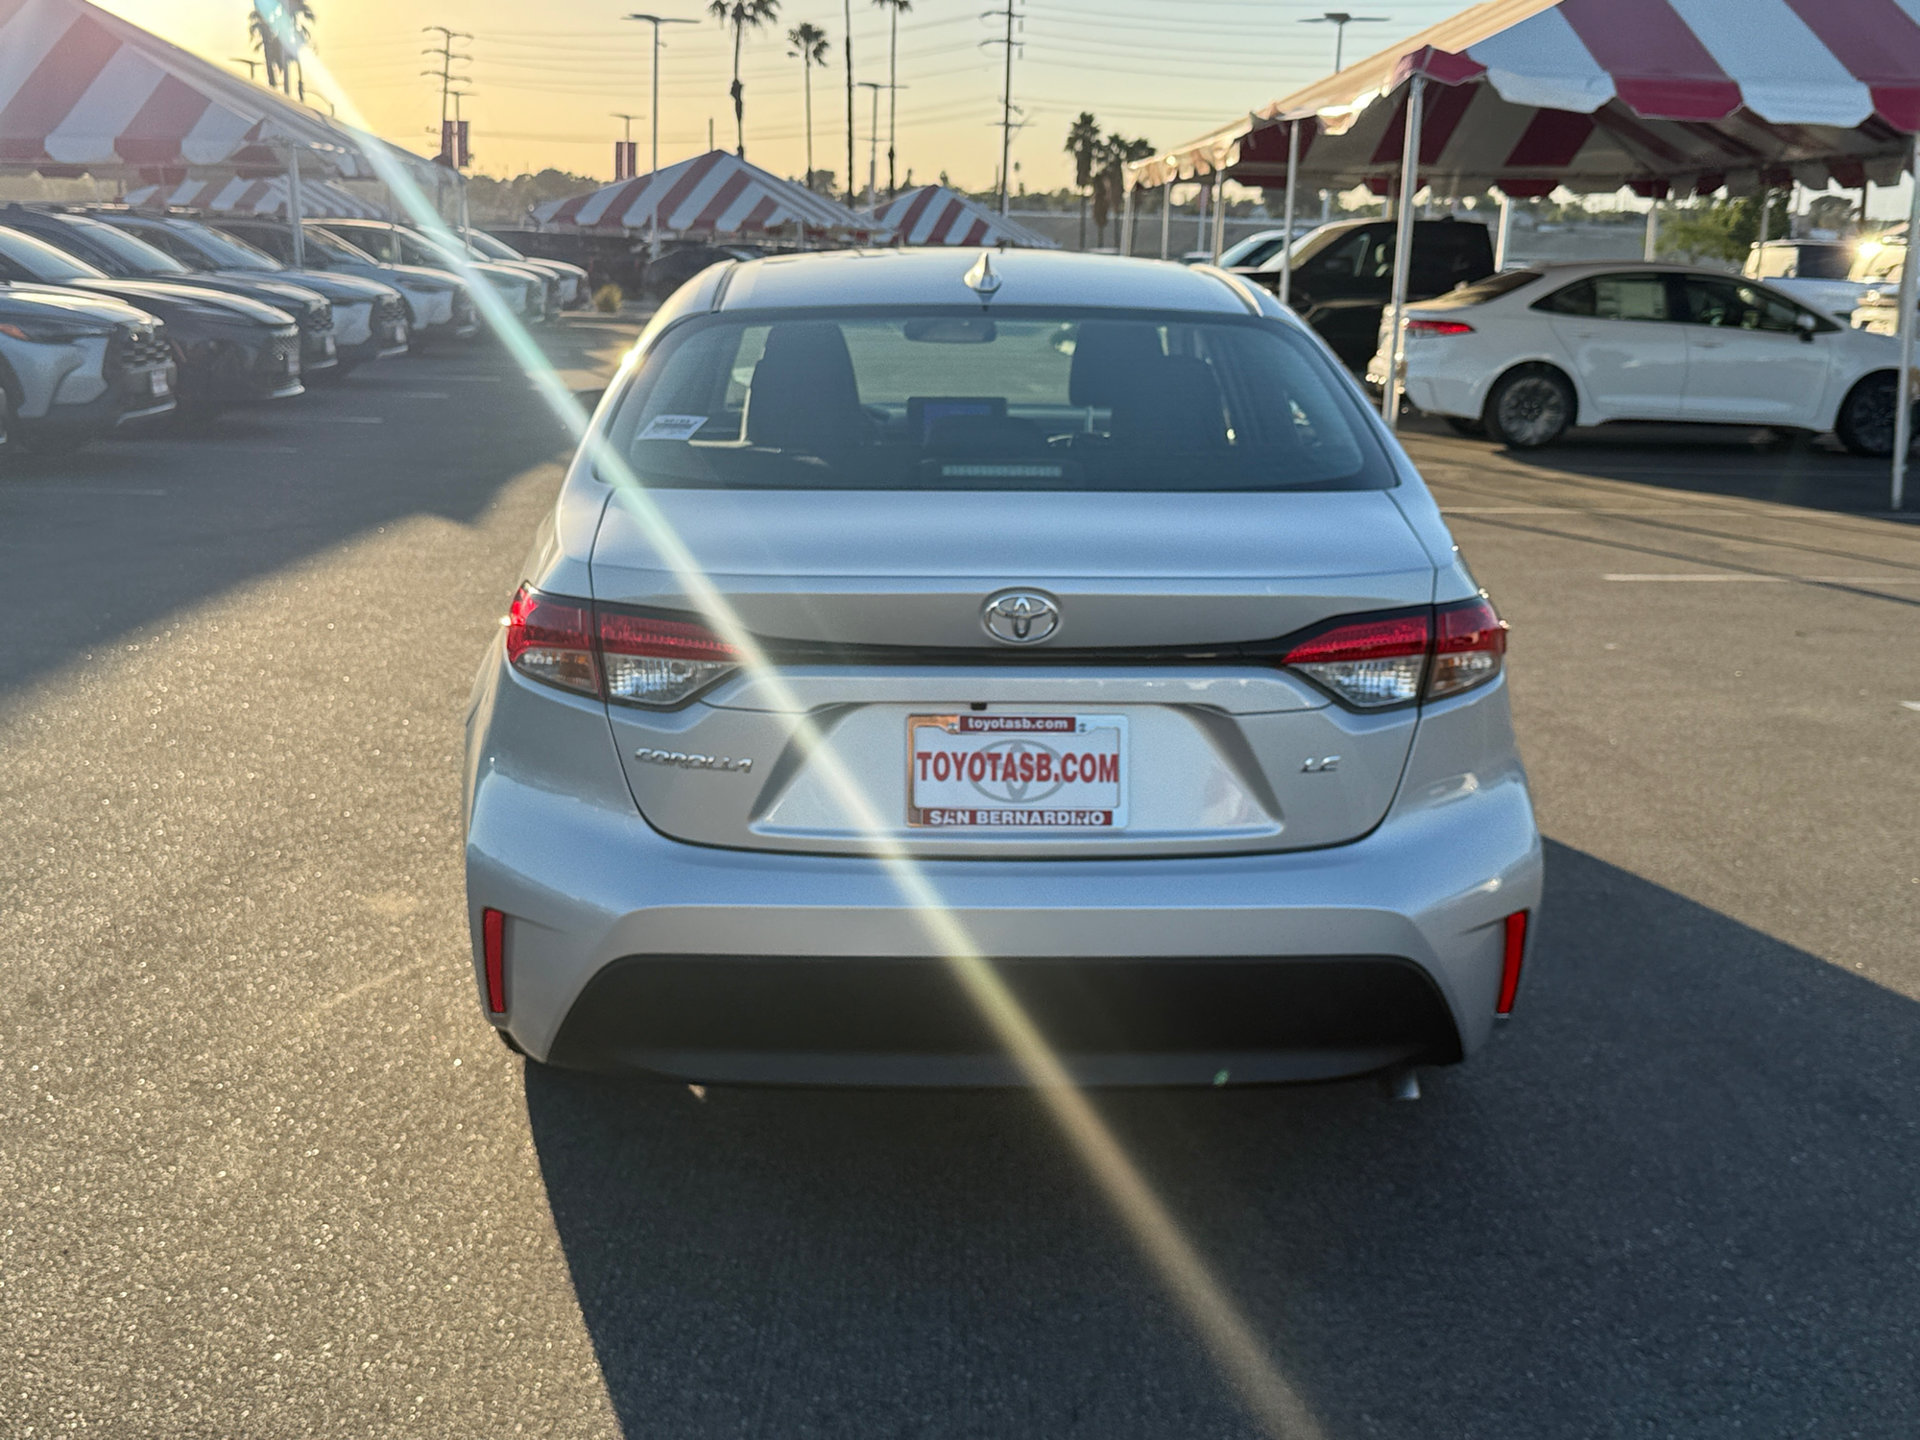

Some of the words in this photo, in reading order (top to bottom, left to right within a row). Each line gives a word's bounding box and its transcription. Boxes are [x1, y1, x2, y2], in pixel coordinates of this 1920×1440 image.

[967, 716, 1069, 732] toyotasb.com
[634, 747, 754, 773] COROLLA
[916, 751, 1119, 783] TOYOTASB.COM
[1301, 755, 1341, 773] LE
[929, 810, 970, 826] SAN
[975, 810, 1105, 826] BERNARDINO
